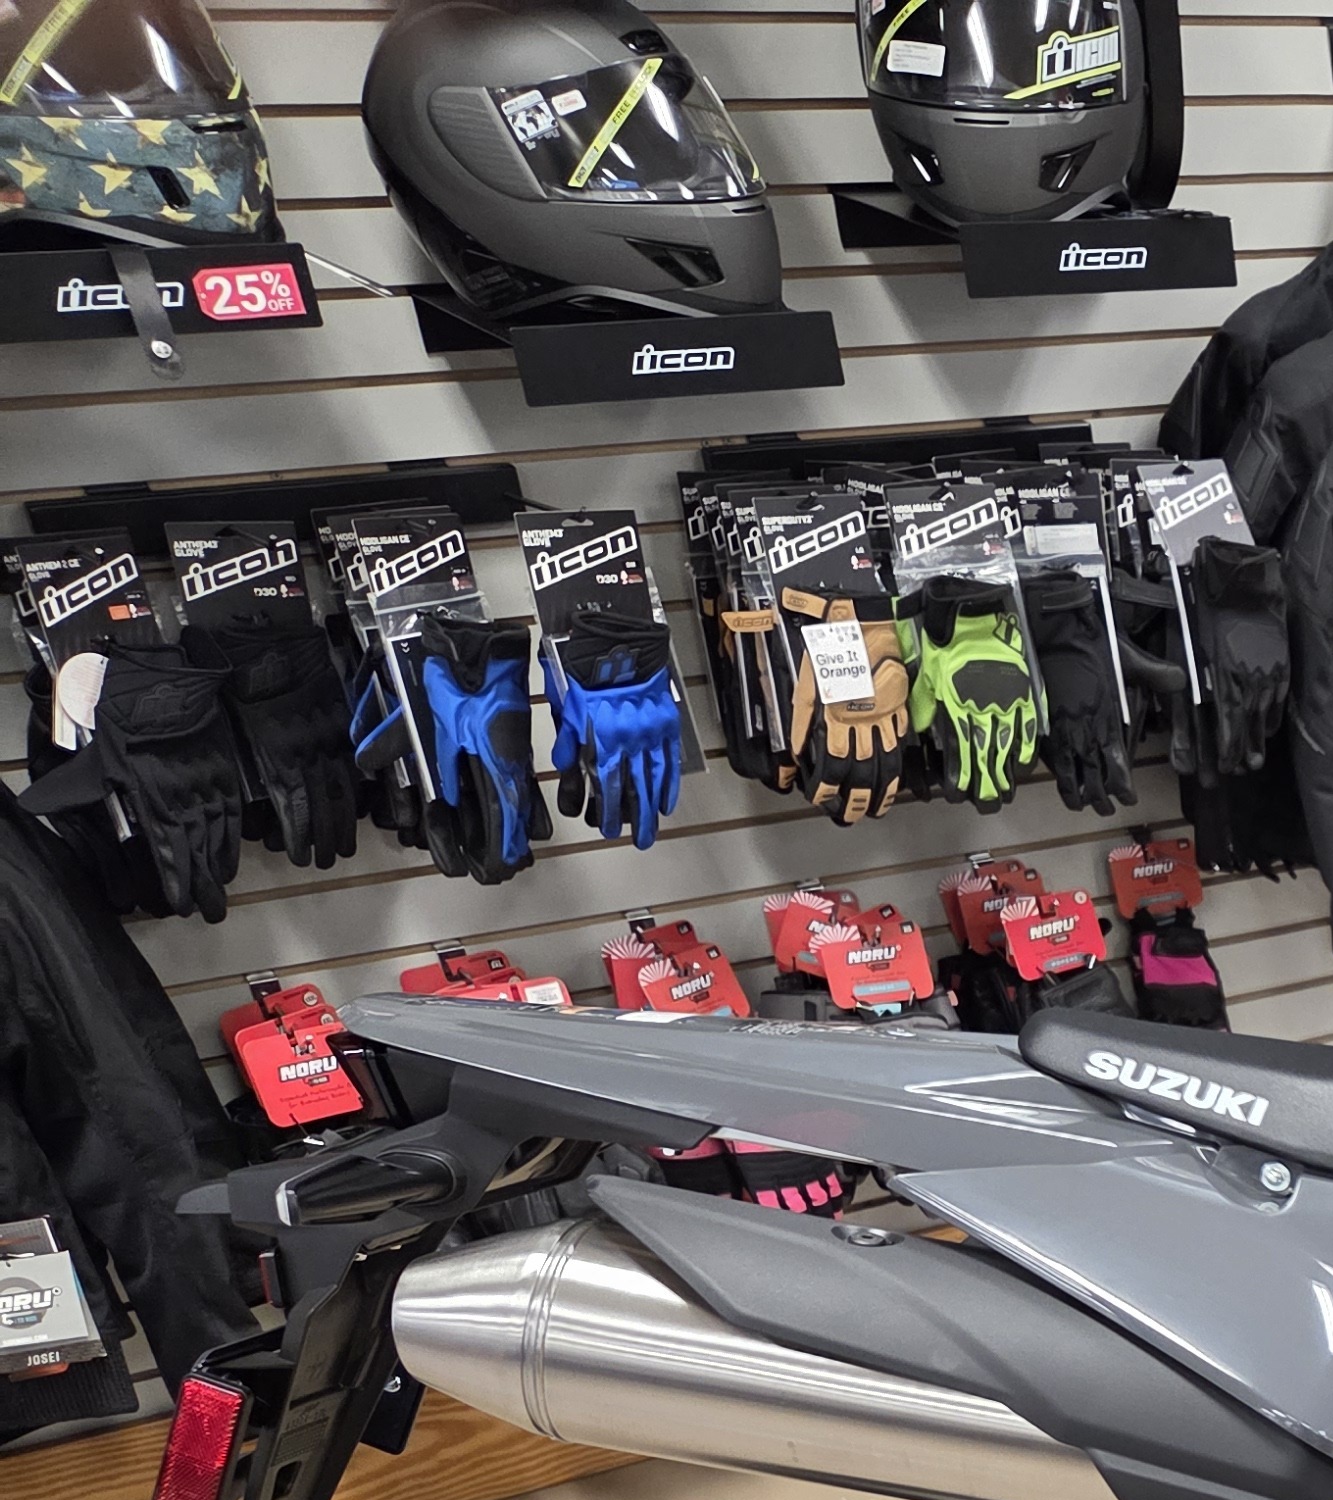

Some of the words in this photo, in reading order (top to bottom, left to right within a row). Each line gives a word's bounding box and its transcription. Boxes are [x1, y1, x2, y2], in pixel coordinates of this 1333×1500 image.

[612, 101, 632, 124] FREE
[1059, 242, 1148, 272] icon
[57, 278, 184, 312] icn
[204, 270, 291, 315] 25%
[267, 298, 295, 312] OFF
[632, 343, 735, 376] icon
[1156, 472, 1233, 531] icon
[360, 535, 399, 545] HOOLIGAN
[769, 510, 866, 575] icon
[899, 497, 999, 561] icon
[26, 561, 61, 573] ANTHEM
[181, 539, 298, 602] icon
[369, 530, 466, 598] icon
[530, 525, 638, 591] icon
[38, 553, 139, 628] icon
[815, 652, 844, 667] Give
[848, 650, 858, 662] It
[820, 664, 867, 680] Orange
[1133, 861, 1174, 879] NORU
[1029, 917, 1076, 941] NORU
[847, 946, 896, 965] NORU
[671, 974, 712, 1001] NORU
[279, 1055, 338, 1082] NORU
[1084, 1049, 1270, 1127] SUZUKI
[27, 1351, 61, 1367] JOSEI
